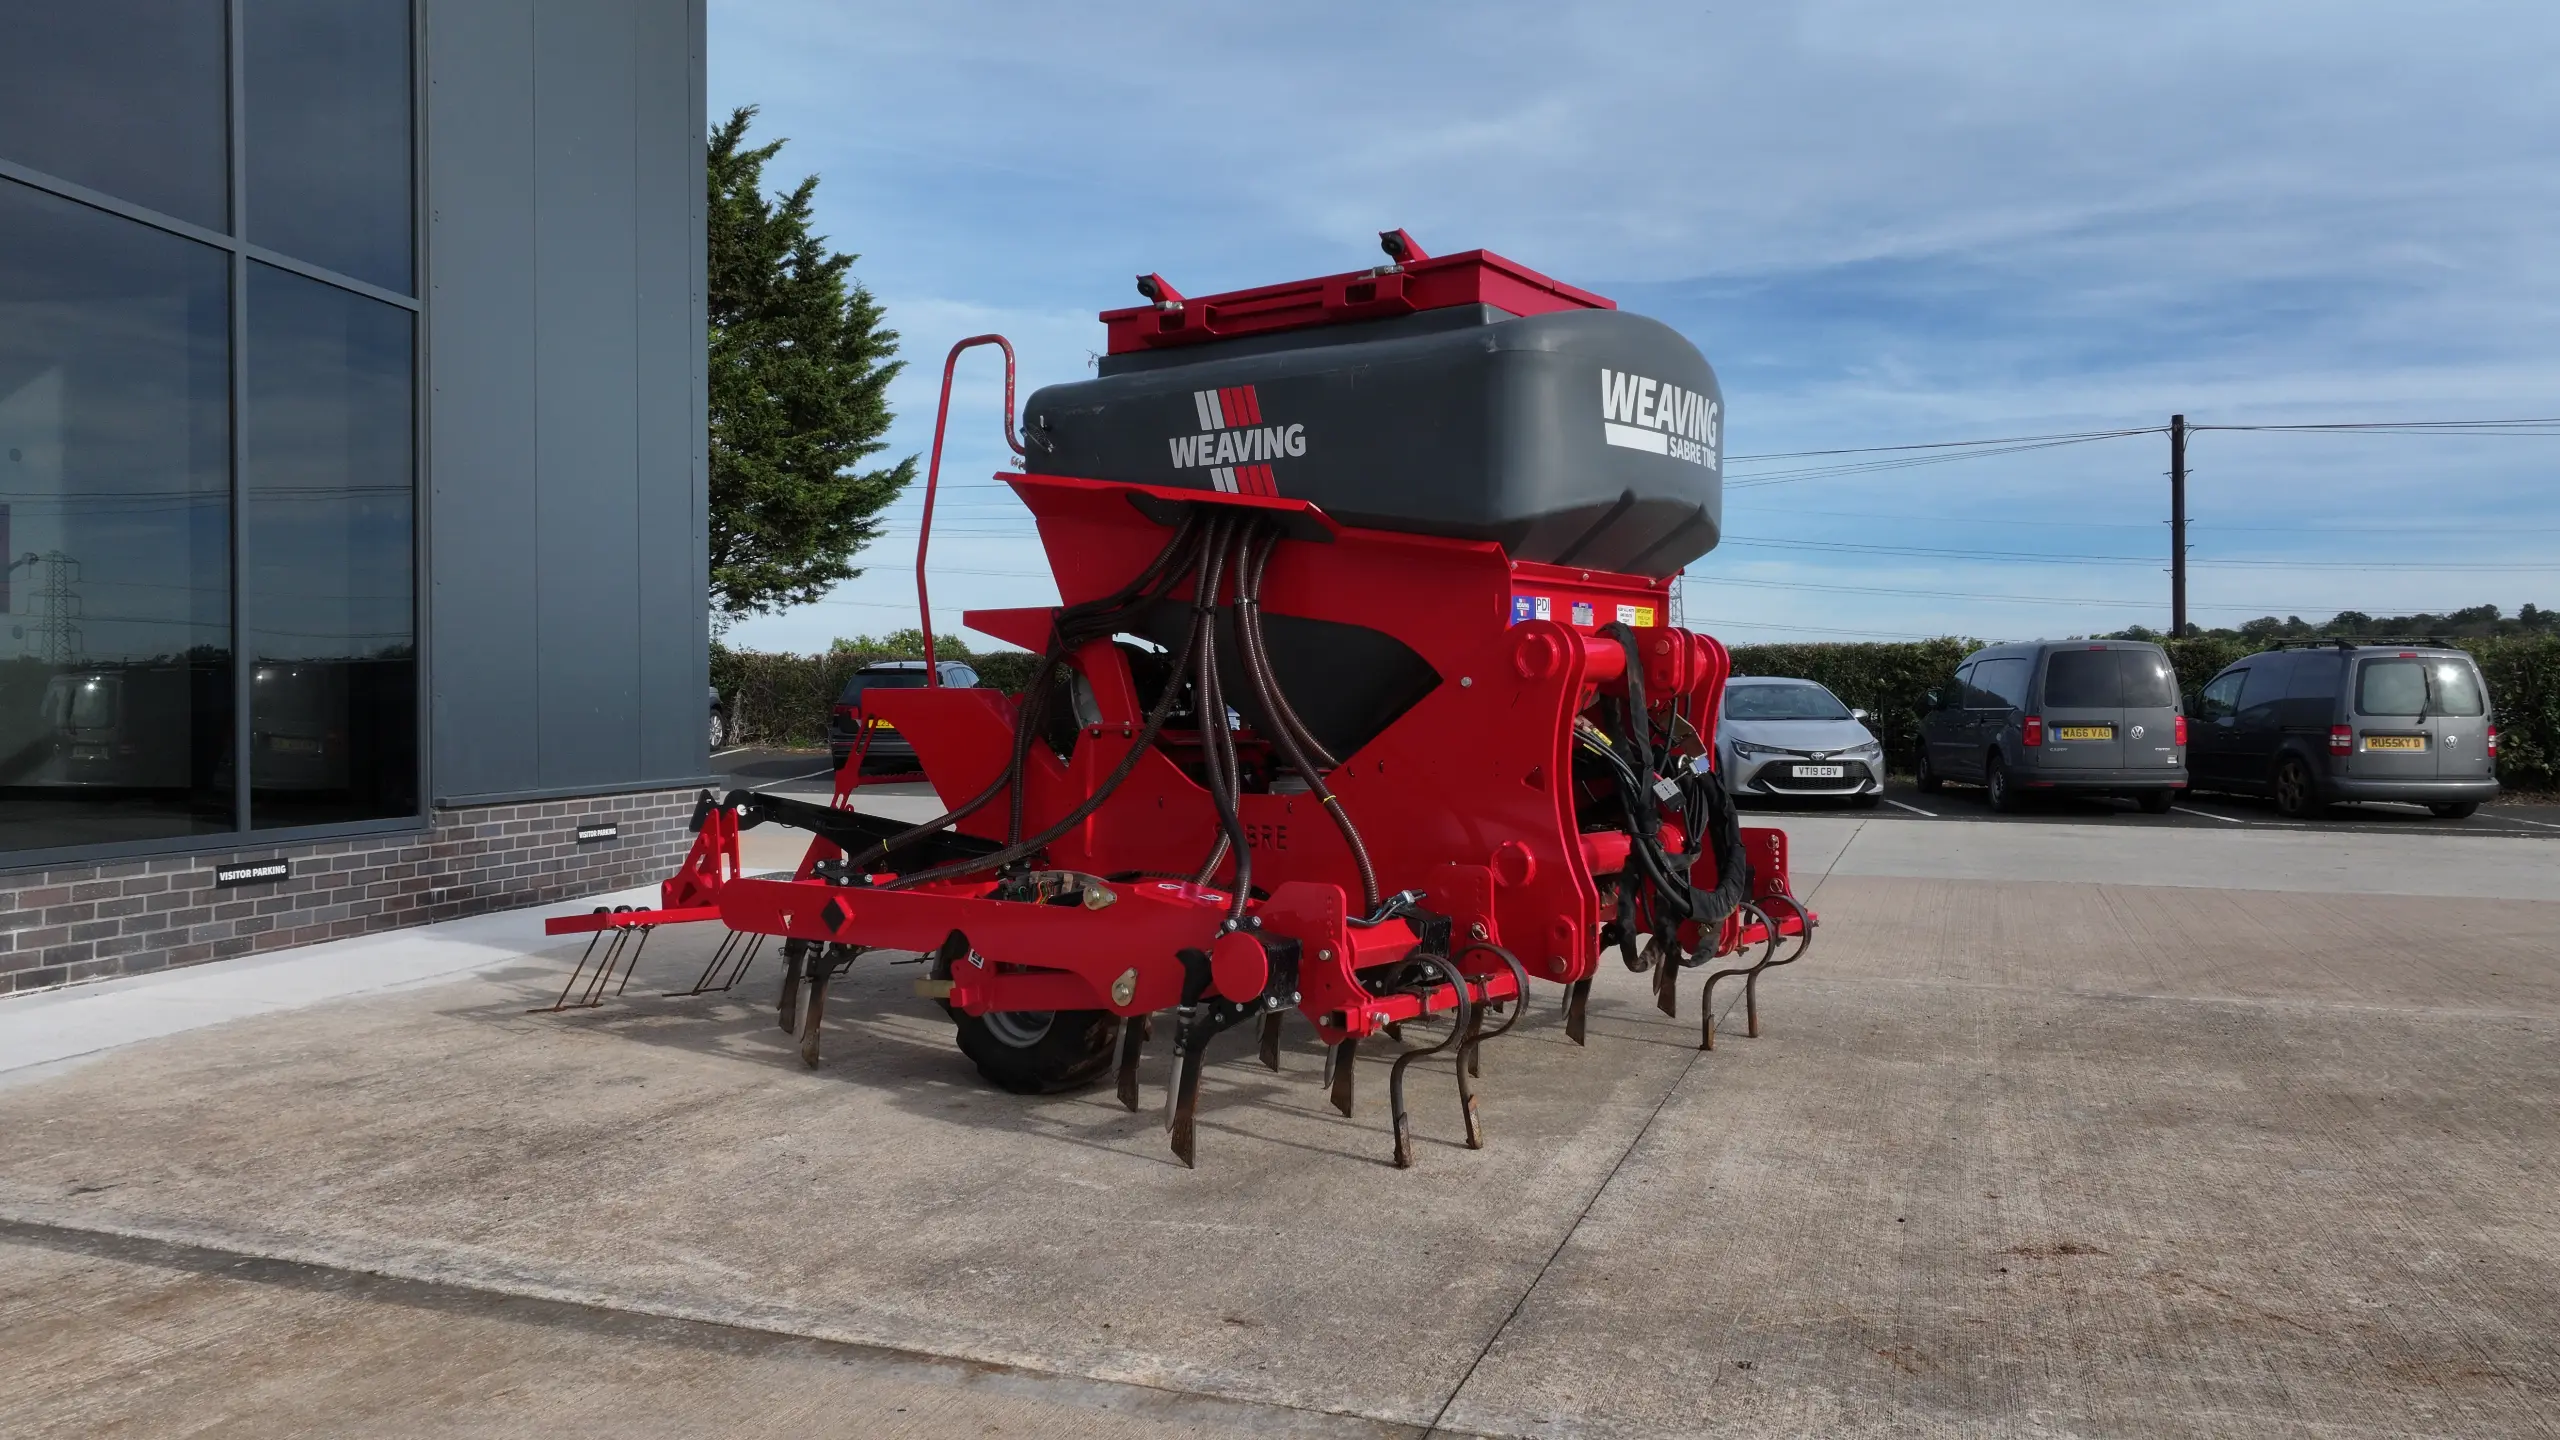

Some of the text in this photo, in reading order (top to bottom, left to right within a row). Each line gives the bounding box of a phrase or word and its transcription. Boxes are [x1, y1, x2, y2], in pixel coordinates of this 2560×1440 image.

[1602, 368, 1718, 448] WEAVING
[1169, 423, 1307, 469] WEAVING
[1670, 436, 1702, 465] SABRE
[1536, 598, 1550, 612] PDI
[2063, 727, 2089, 738] WA66
[1799, 767, 1838, 776] VT19 CBV
[219, 865, 287, 881] VISITOR PARKING
